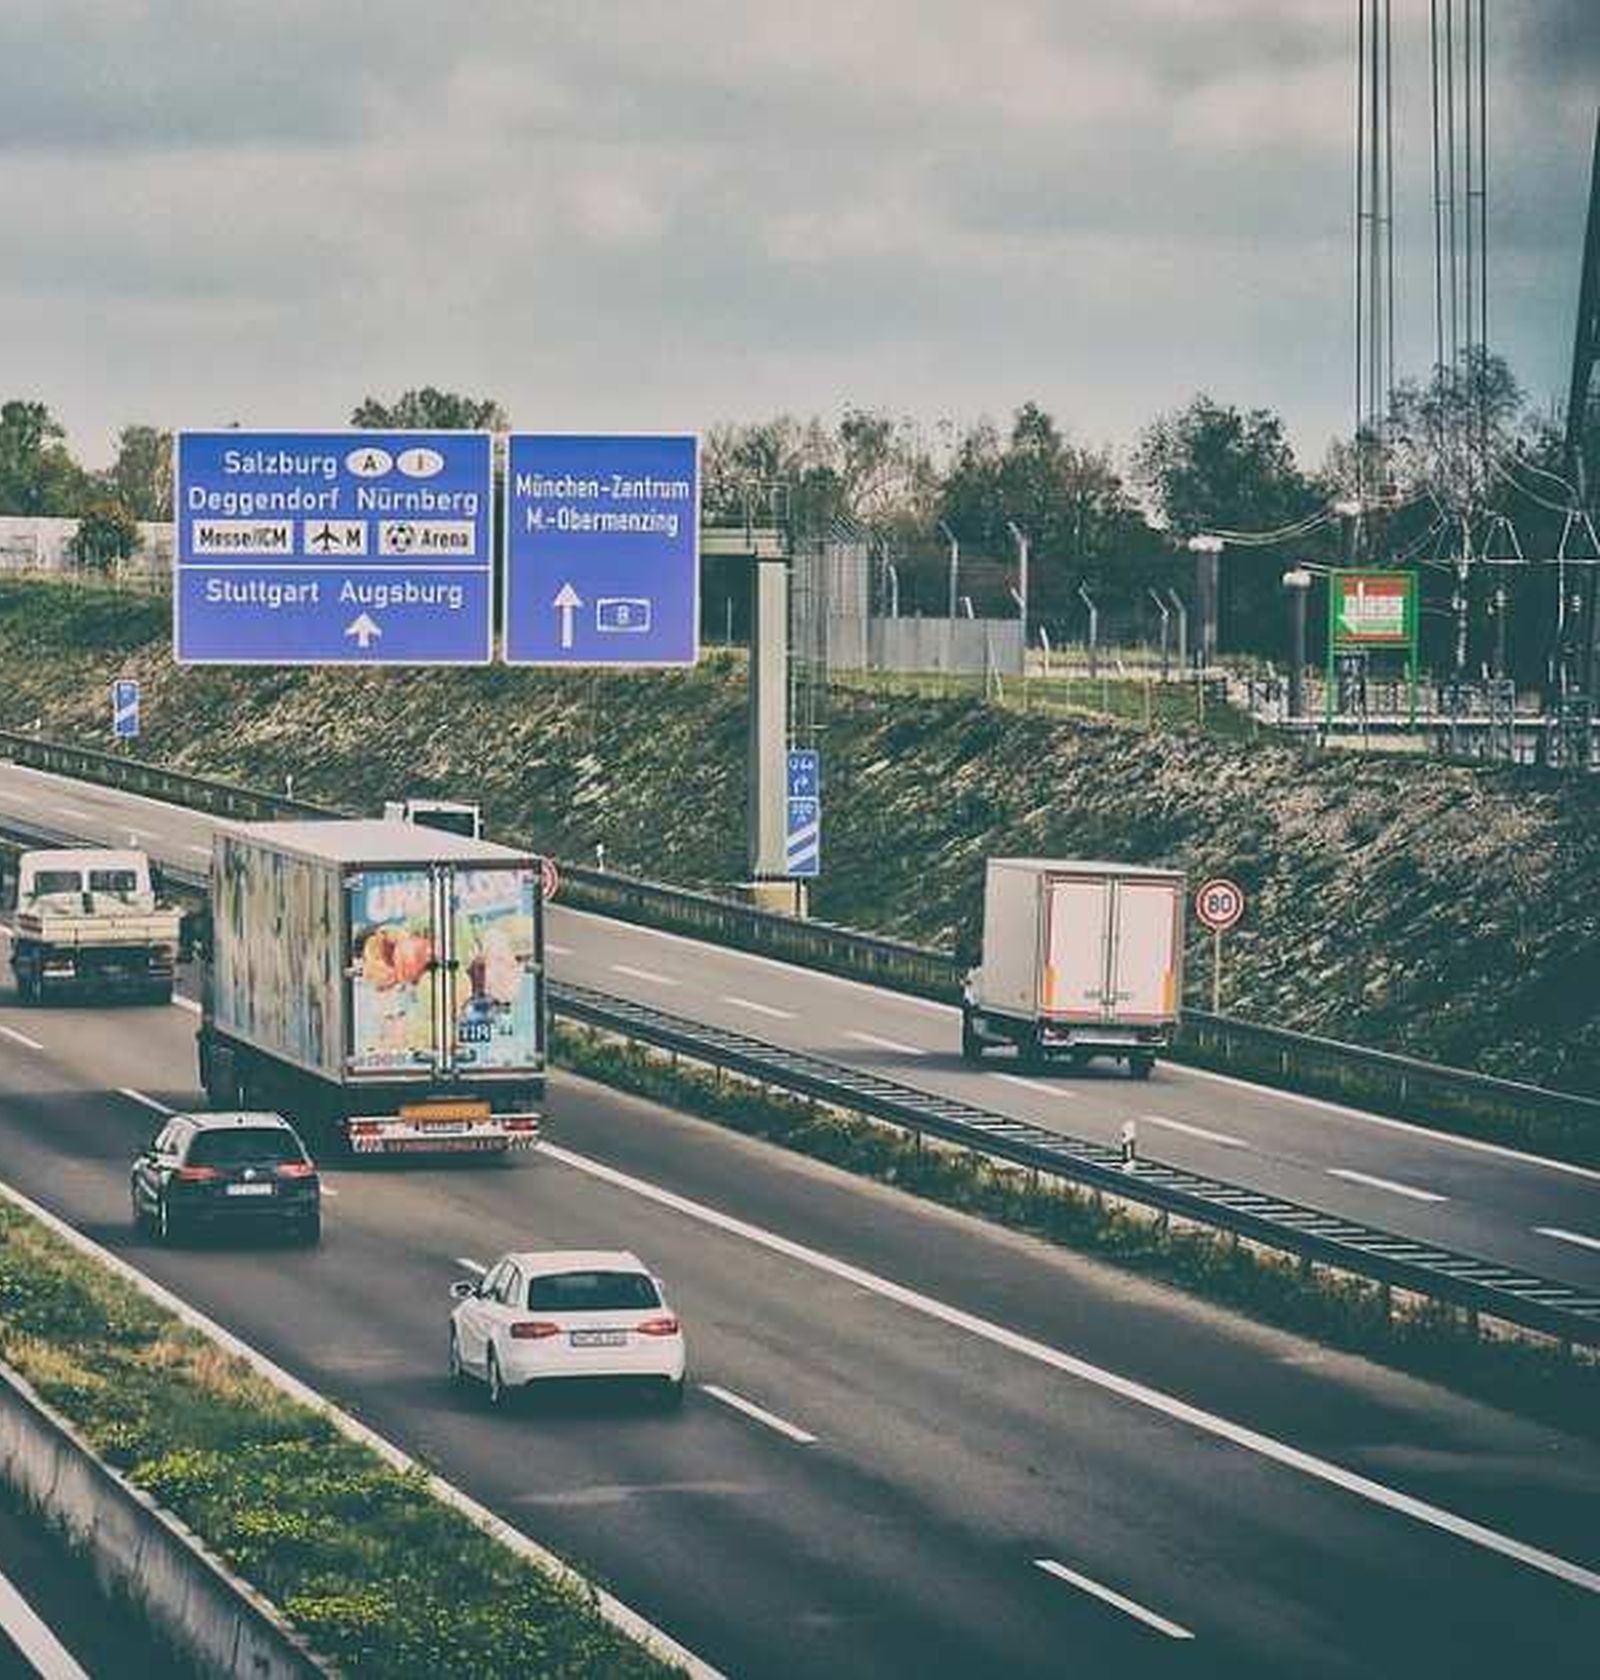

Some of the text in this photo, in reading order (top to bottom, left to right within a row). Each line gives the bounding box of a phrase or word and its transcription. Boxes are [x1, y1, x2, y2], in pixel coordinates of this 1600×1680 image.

[223, 450, 338, 479] Salzburg
[361, 454, 379, 471] A
[516, 473, 689, 499] München-Zentrum
[188, 486, 479, 515] Deggendorf Nürnberg
[526, 506, 679, 538] M.-Obermenzing
[346, 528, 362, 547] M
[420, 527, 469, 547] Arena
[206, 578, 464, 610] Stuttgart Augsburg
[616, 606, 630, 625] 8
[1208, 893, 1232, 914] 80
